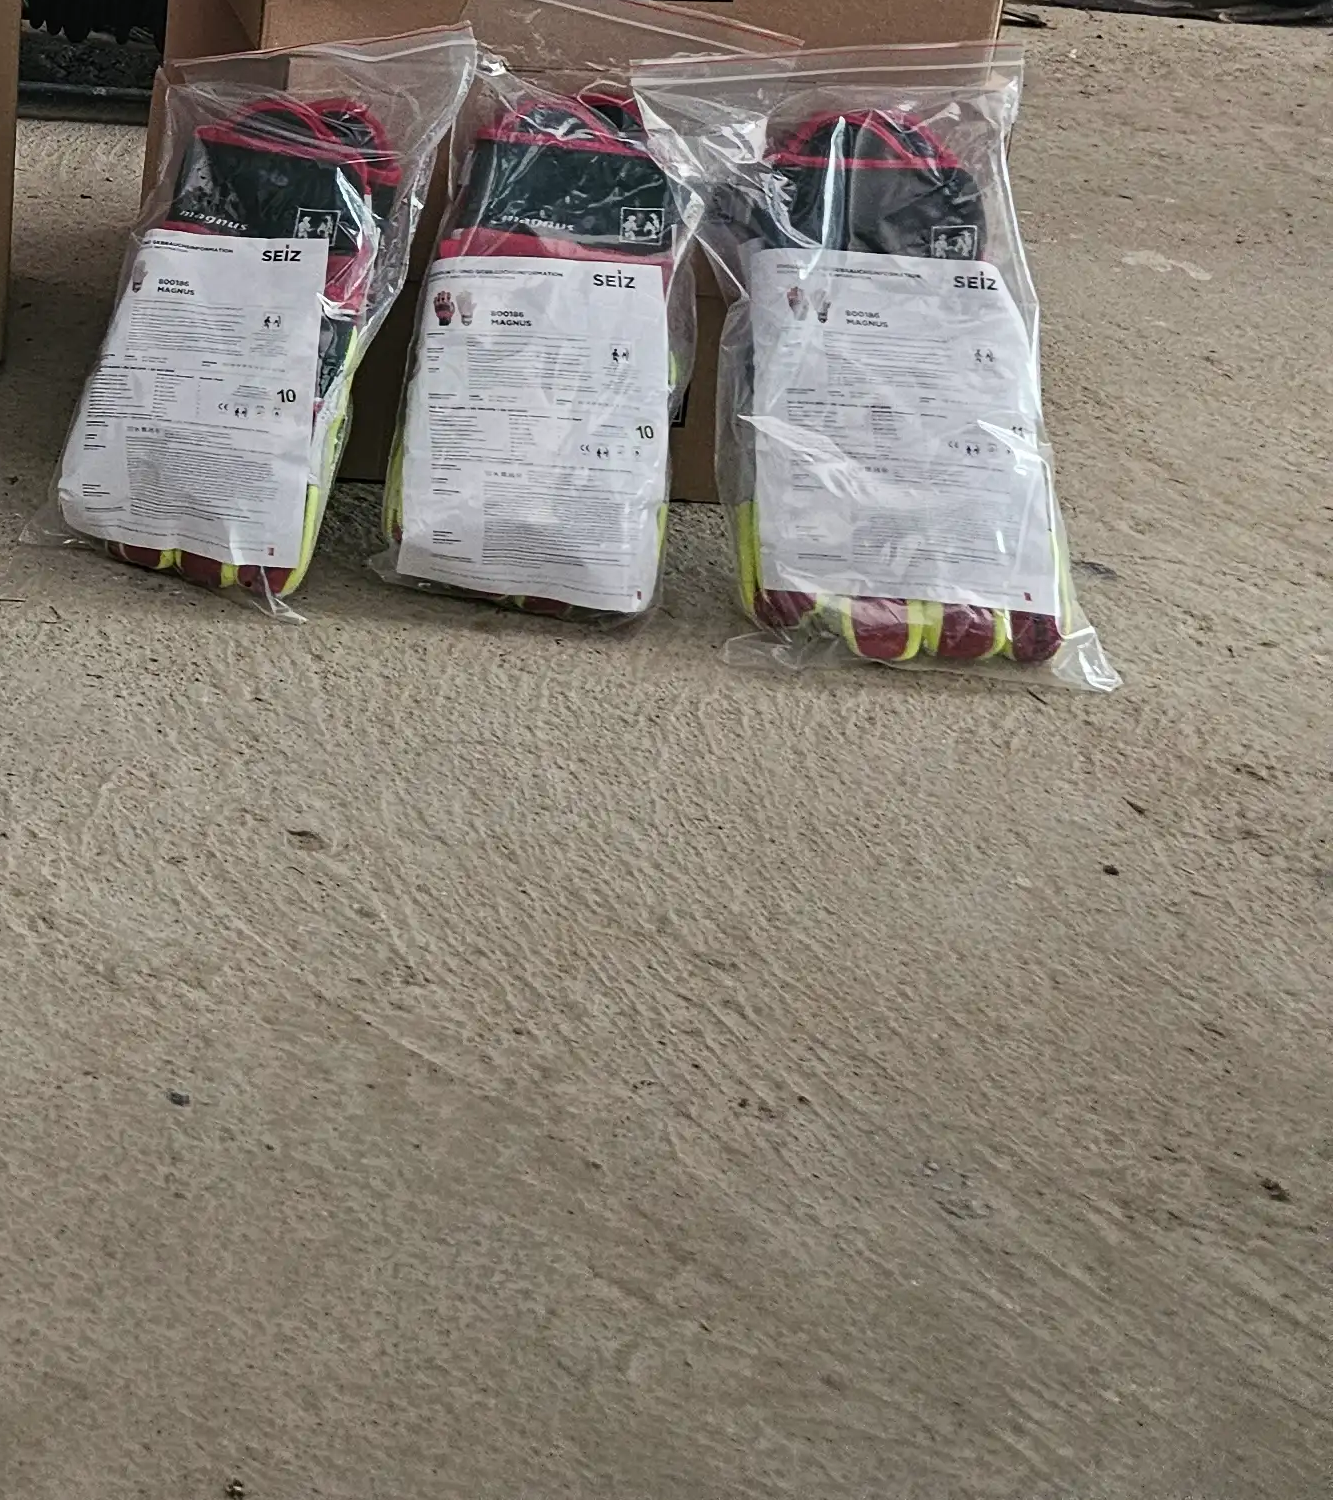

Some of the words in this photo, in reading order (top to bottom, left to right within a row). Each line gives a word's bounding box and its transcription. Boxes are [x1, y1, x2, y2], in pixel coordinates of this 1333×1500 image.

[157, 286, 195, 296] MAGNUS
[490, 318, 532, 327] MAGNUS
[276, 388, 297, 403] 10
[635, 425, 654, 440] 10
